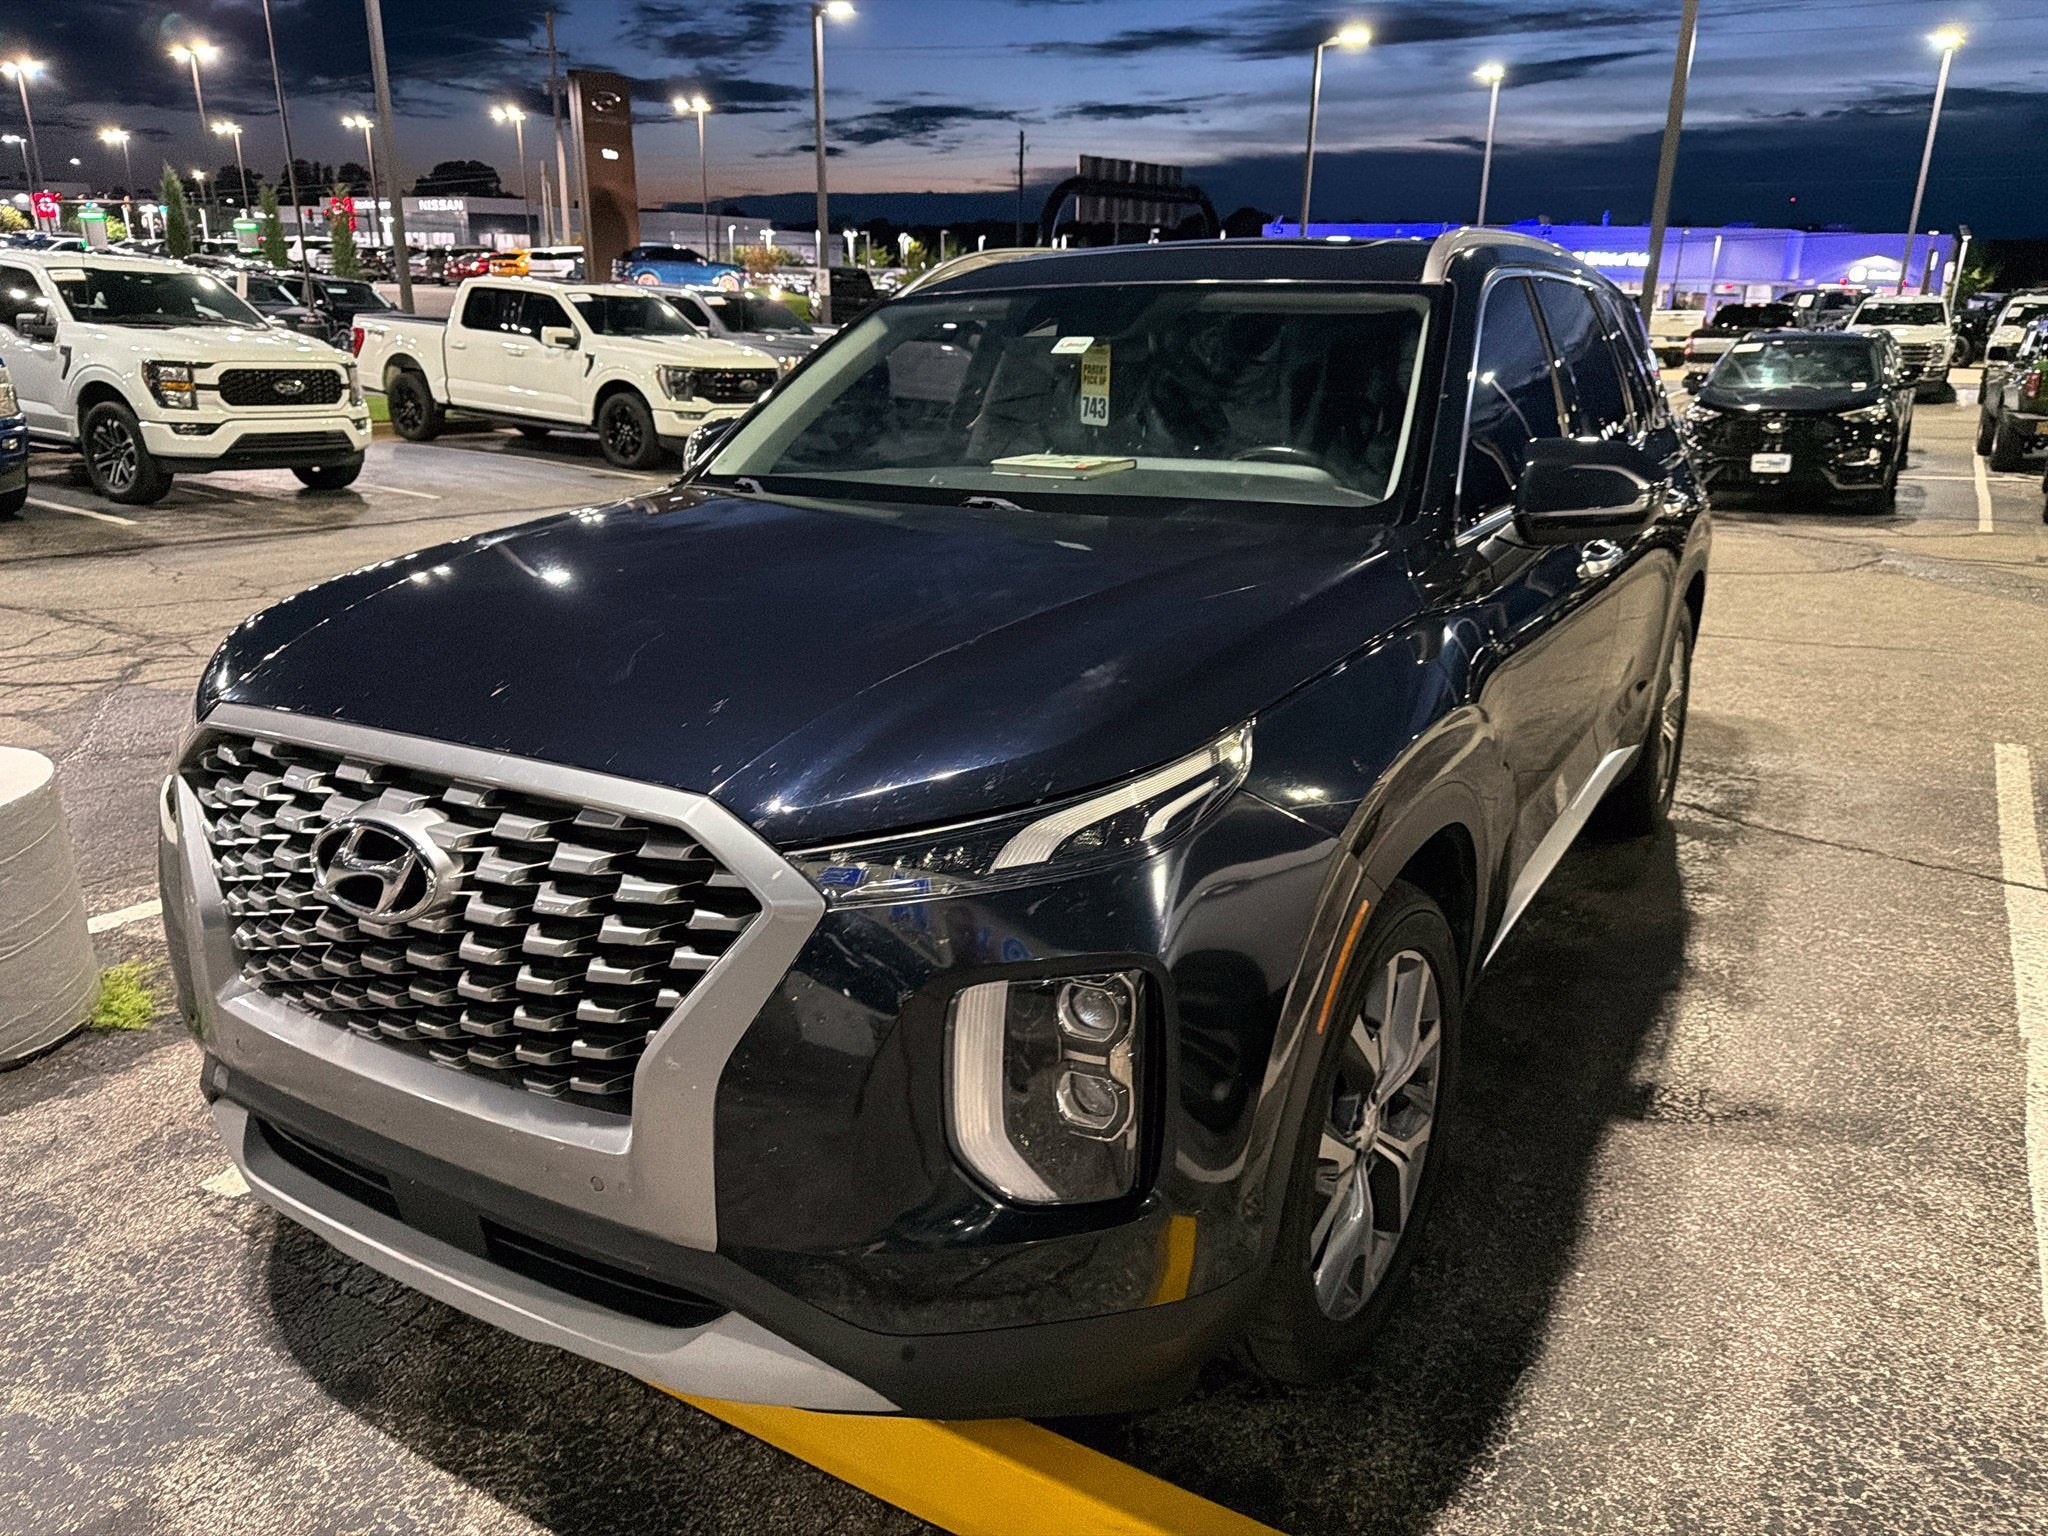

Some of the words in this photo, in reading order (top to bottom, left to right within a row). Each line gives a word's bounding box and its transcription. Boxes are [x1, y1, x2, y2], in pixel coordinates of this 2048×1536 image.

[418, 199, 464, 211] NISSAN
[1083, 364, 1107, 375] PARENT
[1083, 375, 1097, 385] PICK
[1083, 396, 1107, 419] 743
